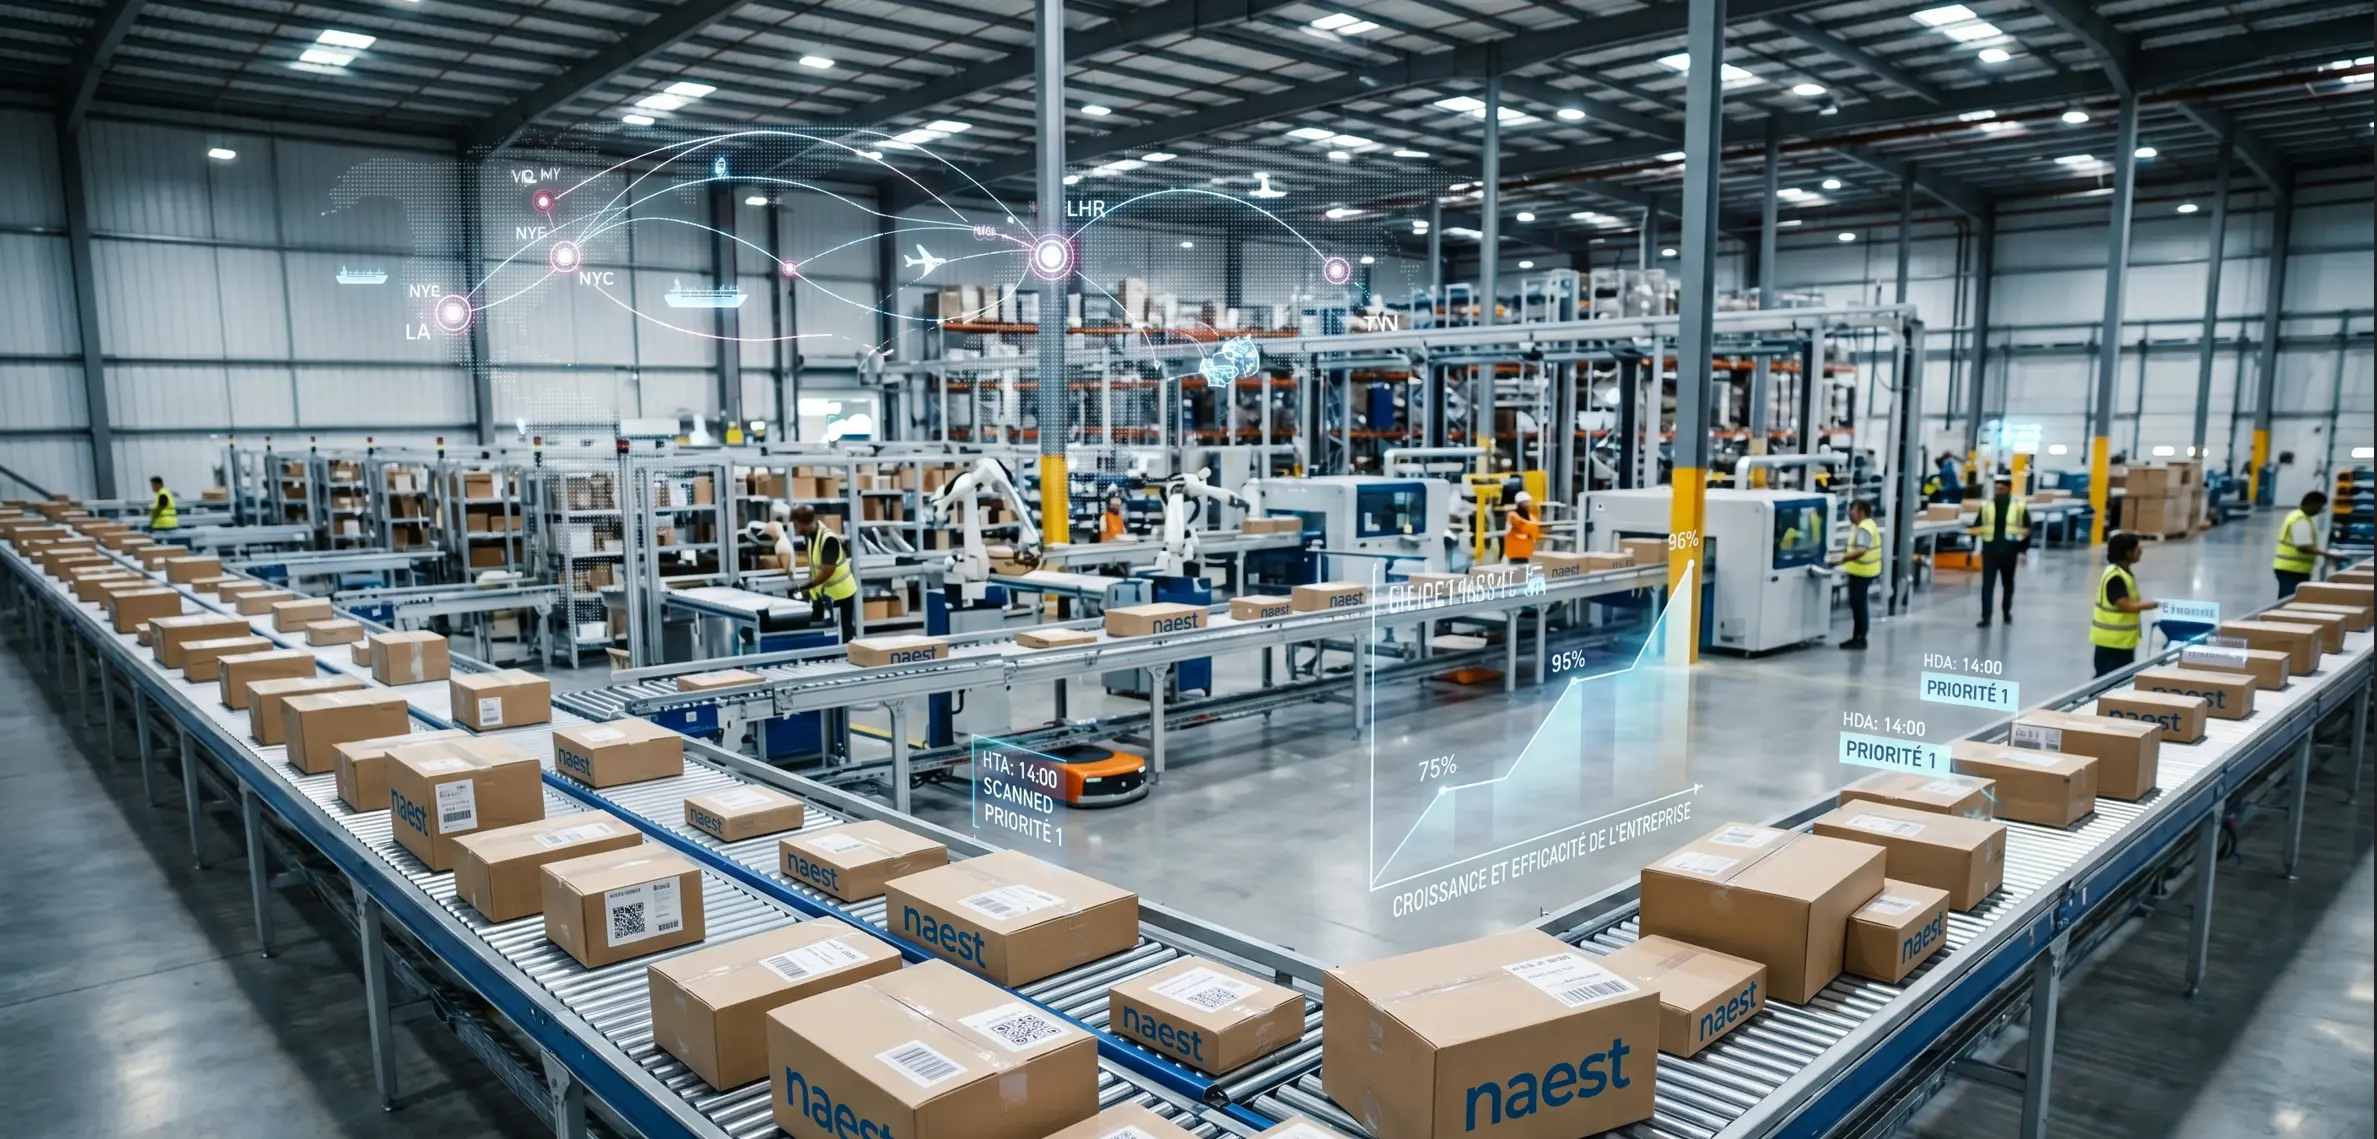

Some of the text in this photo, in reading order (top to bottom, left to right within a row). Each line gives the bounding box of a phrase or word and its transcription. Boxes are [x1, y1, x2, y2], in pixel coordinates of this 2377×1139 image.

[1551, 564, 1580, 578] naest
[1329, 591, 1364, 608] naest
[1152, 612, 1198, 634] naest
[890, 644, 937, 664] naest
[558, 747, 592, 777] naest
[391, 787, 429, 837] naest
[690, 807, 723, 835] naest
[787, 851, 840, 892] naest
[903, 904, 986, 970] naest
[1902, 910, 1944, 965] naest
[1700, 980, 1757, 1042] naest
[1123, 1002, 1204, 1063] naest
[1465, 1037, 1632, 1132] naest
